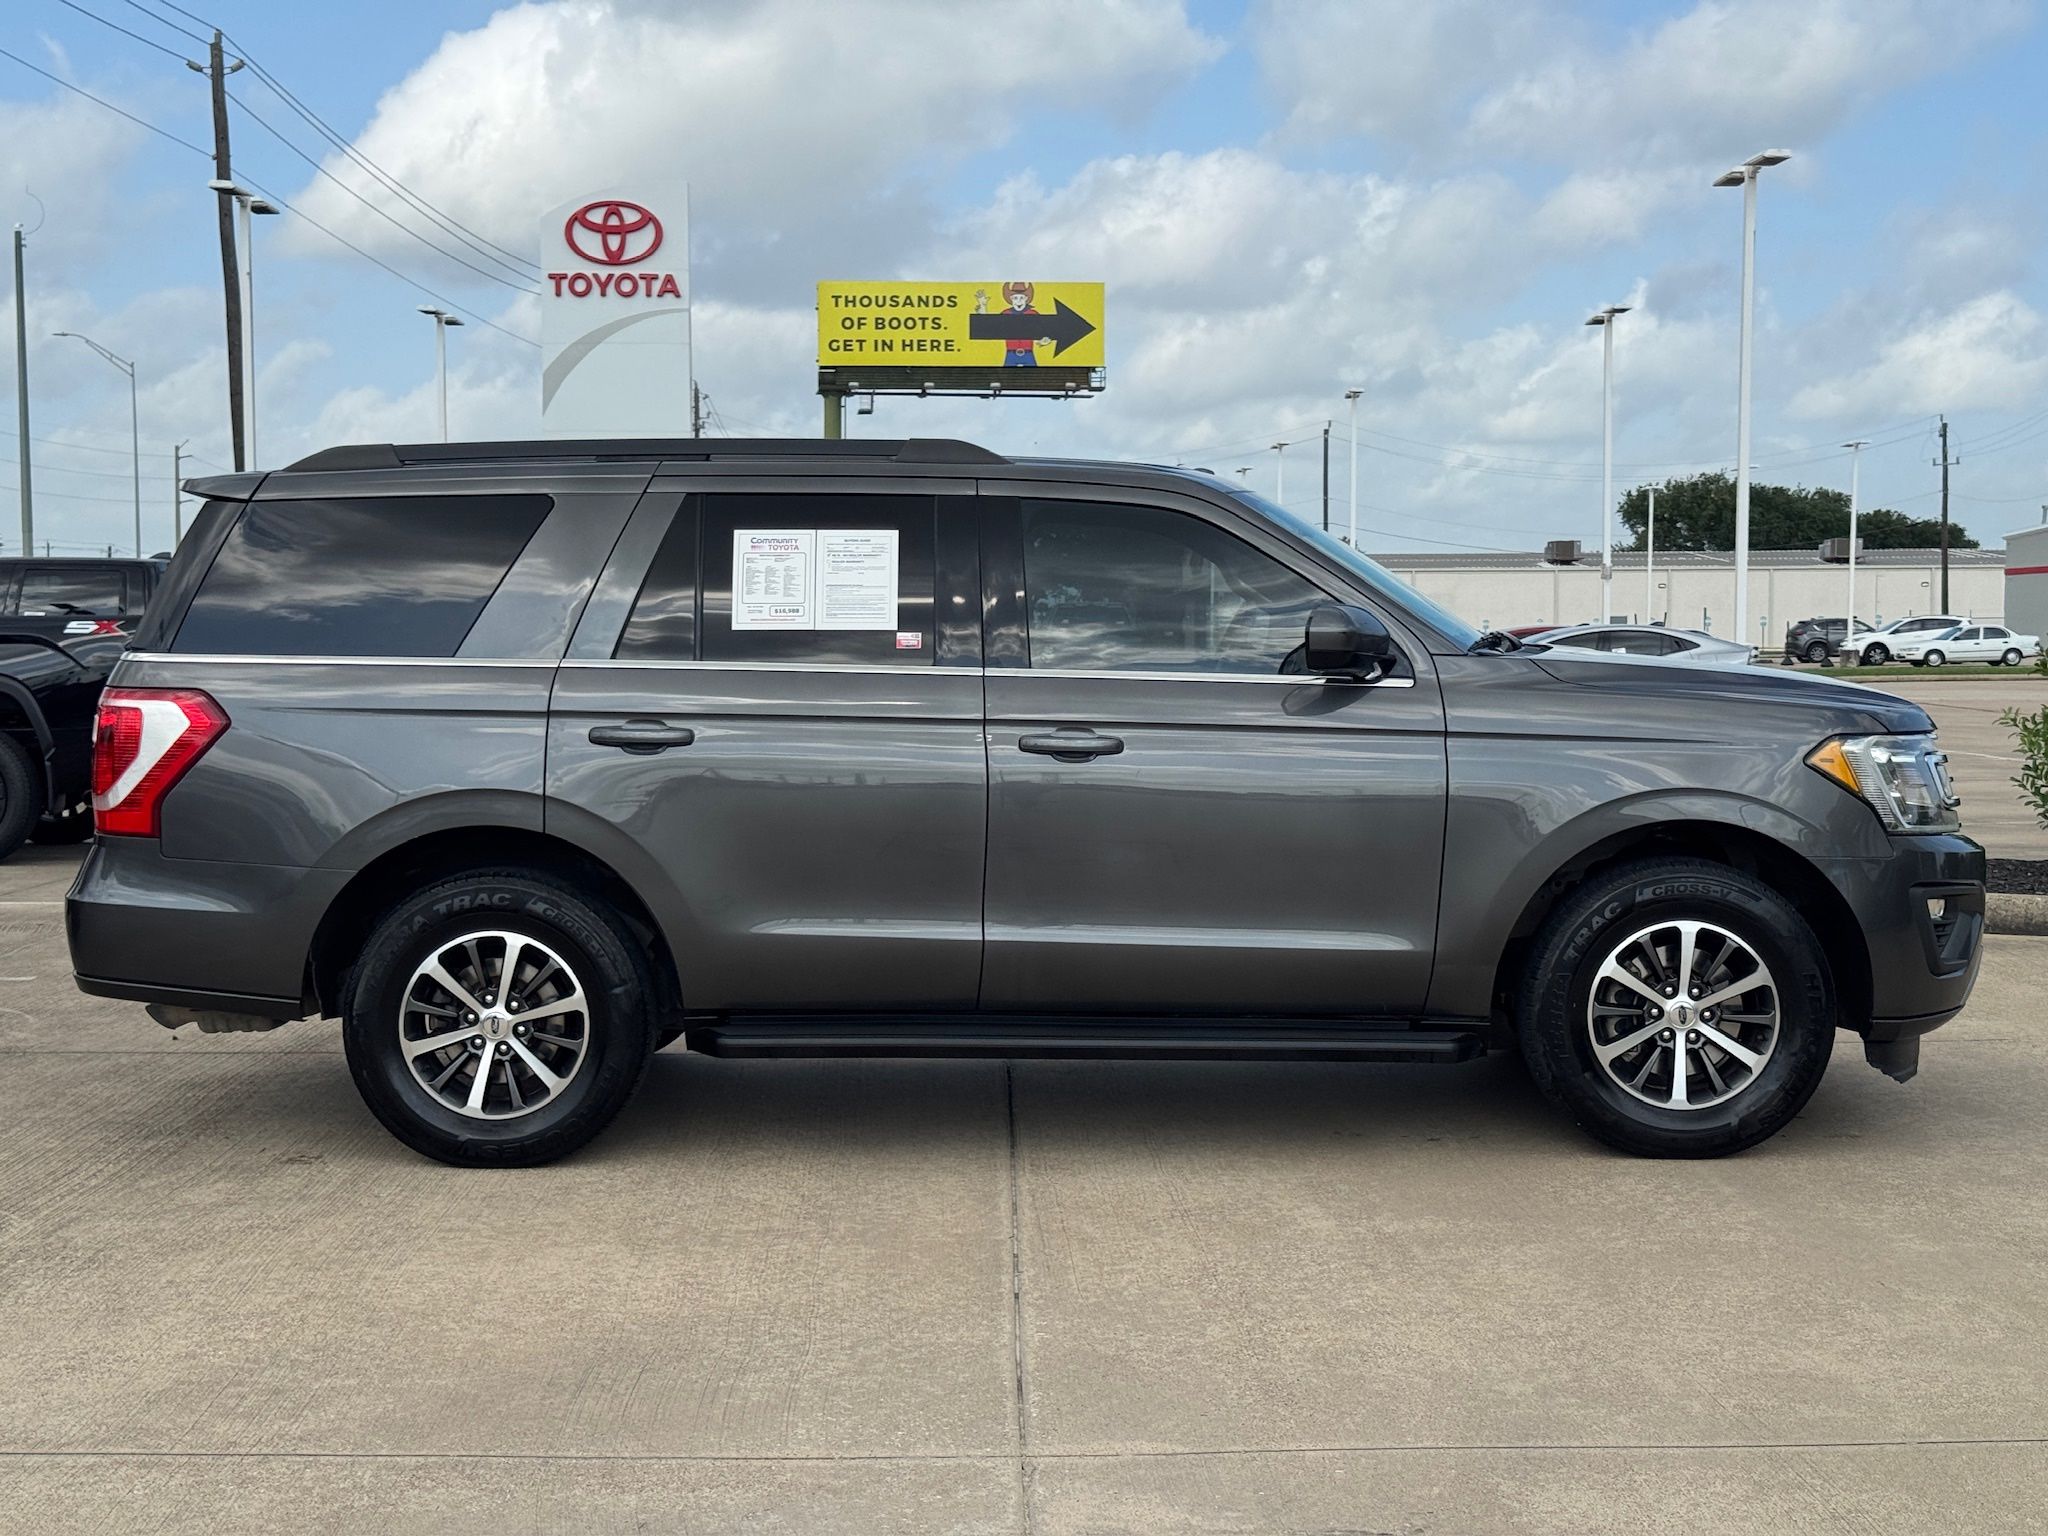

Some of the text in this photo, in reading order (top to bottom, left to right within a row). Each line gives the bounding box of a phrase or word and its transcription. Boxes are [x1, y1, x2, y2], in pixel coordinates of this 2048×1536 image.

[548, 273, 681, 298] TOYOTA
[831, 295, 958, 308] THOUSANDS
[841, 317, 948, 330] OF BOOTS.
[828, 339, 961, 352] GET IN HERE.
[432, 893, 513, 916] TRAC
[1562, 884, 1733, 961] TRAC CROSS-V
